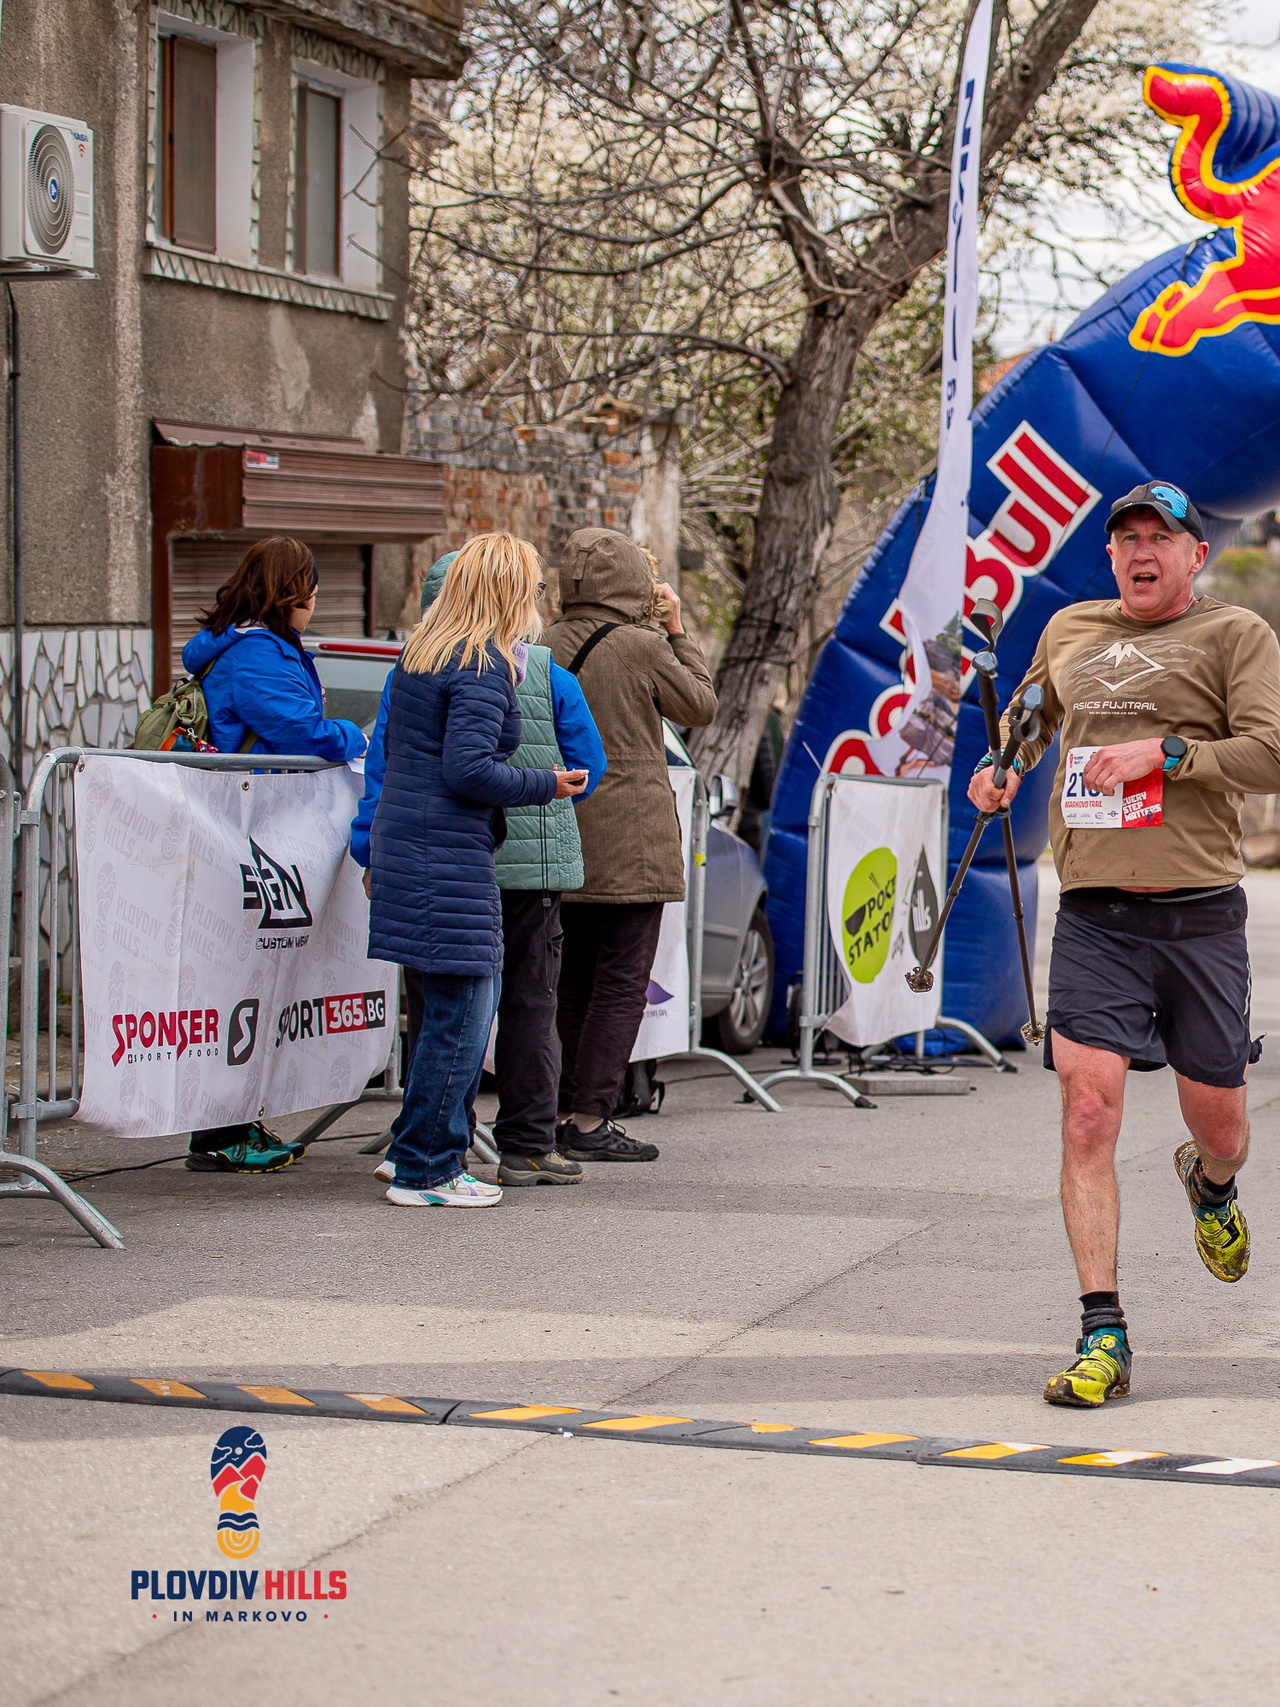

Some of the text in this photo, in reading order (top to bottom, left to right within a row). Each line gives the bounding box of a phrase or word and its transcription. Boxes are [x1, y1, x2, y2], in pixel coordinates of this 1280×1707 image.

[1072, 700, 1158, 711] ASICS FUJITRAIL
[1065, 800, 1102, 809] MARKOVO TRAIL
[1122, 801, 1143, 815] STEP
[111, 1008, 219, 1067] SPONSER
[134, 1047, 219, 1063] SPORT FOOD
